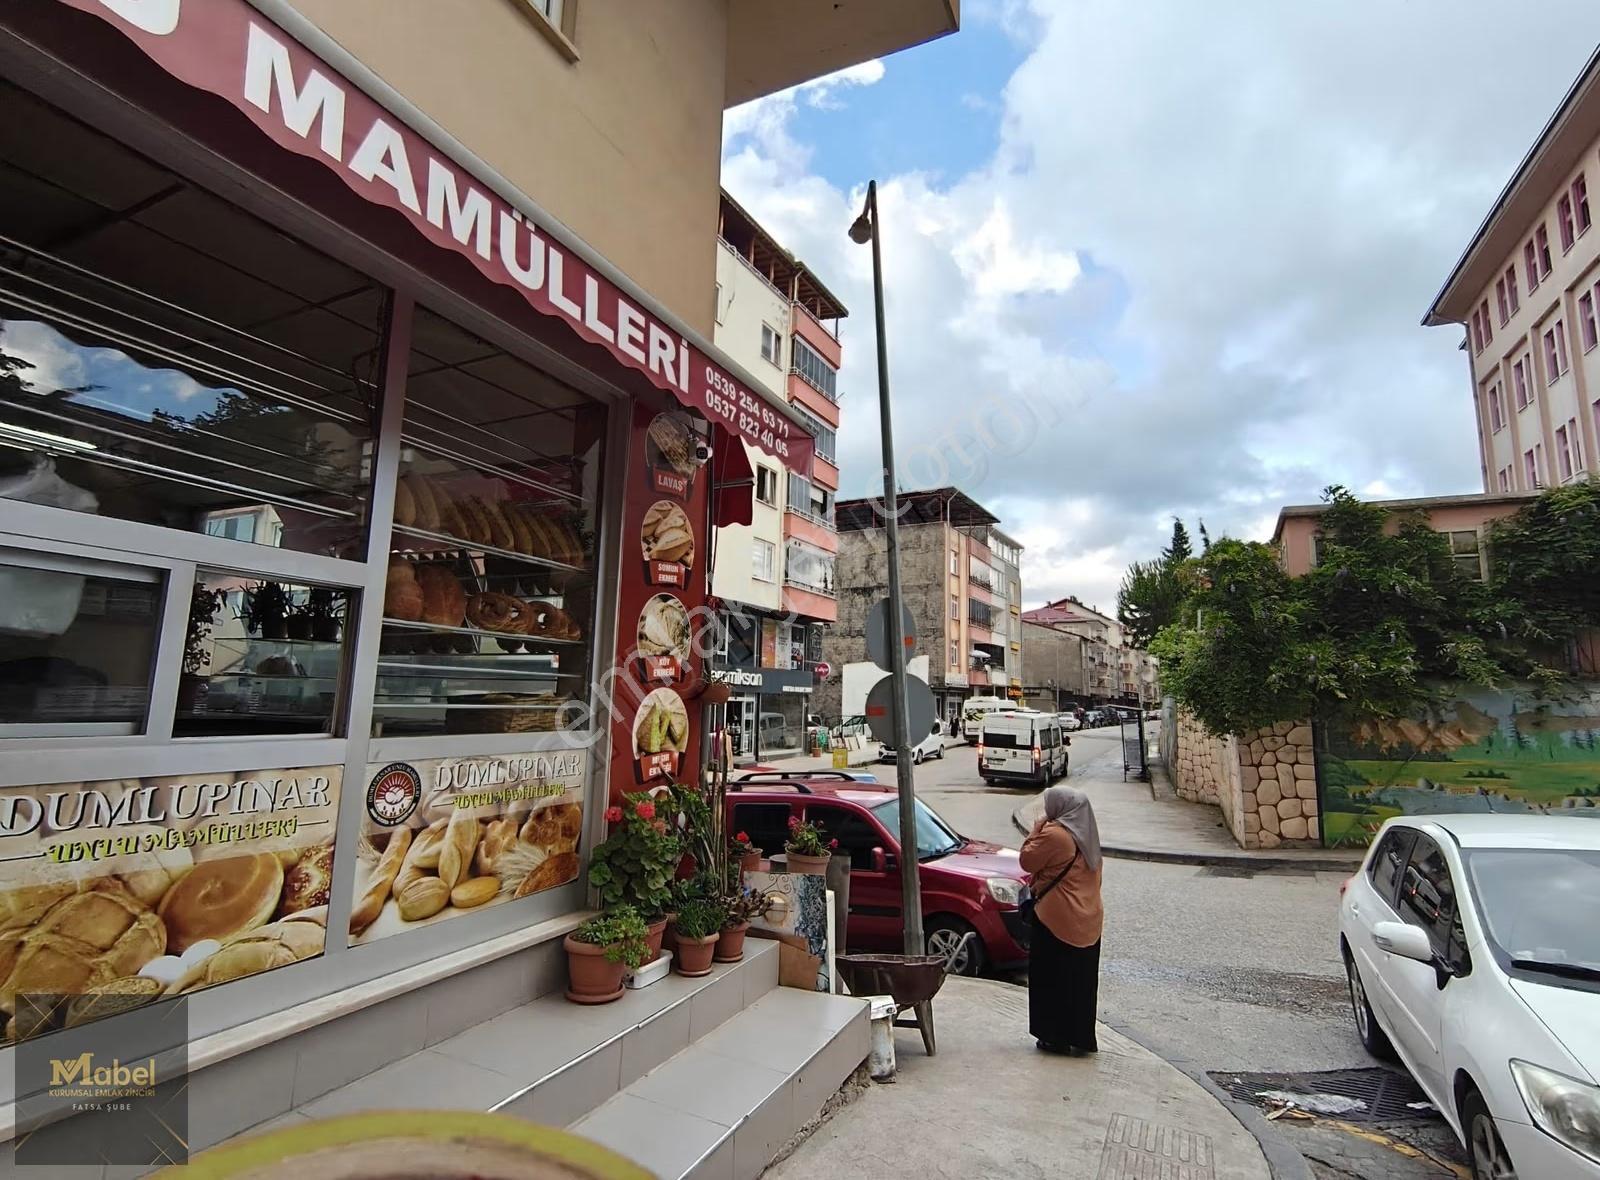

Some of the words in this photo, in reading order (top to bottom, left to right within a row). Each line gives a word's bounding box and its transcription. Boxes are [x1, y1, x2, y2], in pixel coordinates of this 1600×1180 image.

[243, 20, 690, 395] MAMÜLLERİ
[705, 366, 737, 401] 0539
[739, 390, 760, 418] 254
[762, 408, 776, 428] 63
[777, 417, 789, 438] 71
[705, 389, 737, 422] 0537
[739, 412, 760, 439] 823
[761, 429, 774, 448] 40
[775, 438, 789, 457] 05
[658, 562, 679, 574] SOMUN
[658, 574, 678, 584] EKMEK
[710, 669, 764, 687] eramiksan
[434, 753, 583, 793] DUMLUPINAR
[0, 775, 332, 838] DUMLUPINAR
[142, 814, 300, 853] MAMÜLLERİ
